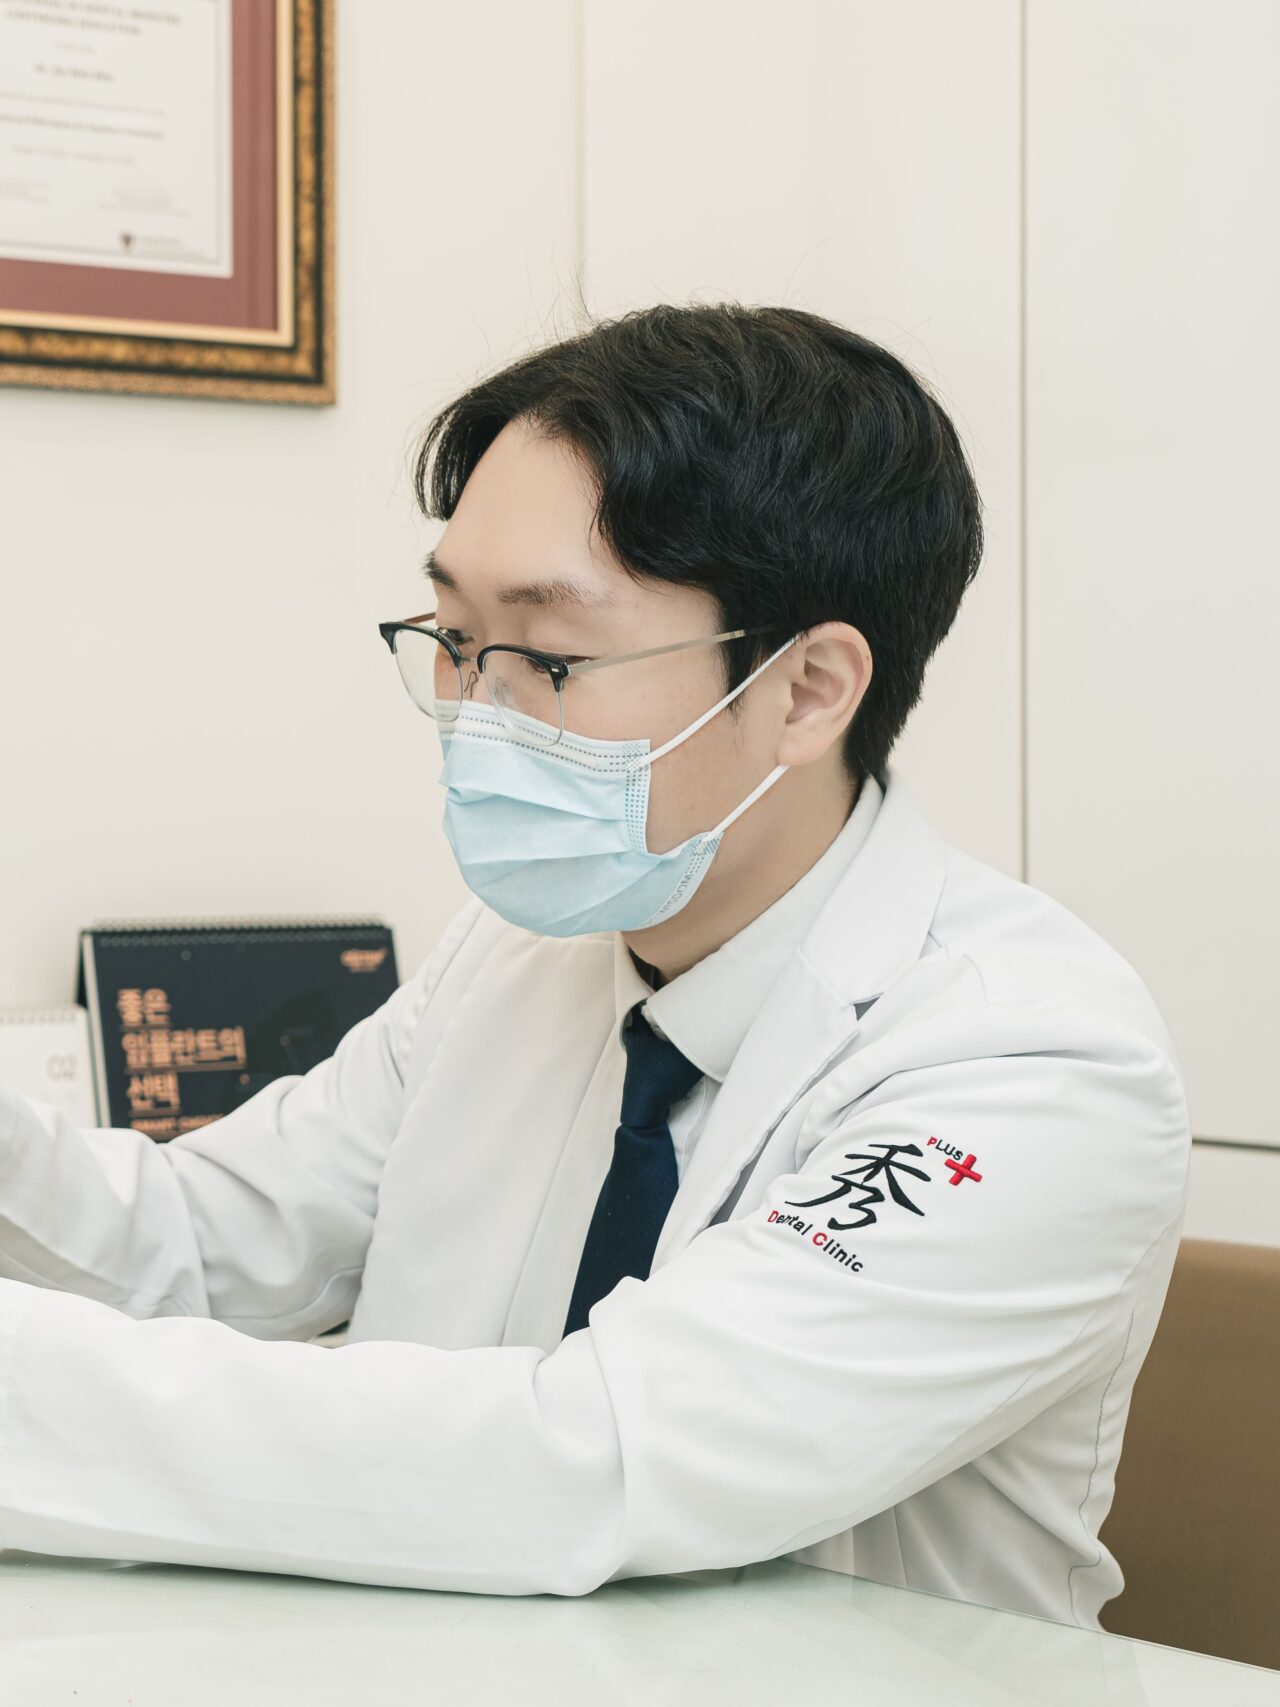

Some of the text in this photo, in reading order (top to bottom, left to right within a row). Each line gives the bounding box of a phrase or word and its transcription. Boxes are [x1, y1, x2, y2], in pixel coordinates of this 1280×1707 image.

[926, 1136, 964, 1162] PLUS
[767, 1210, 864, 1273] Dental Clinic
